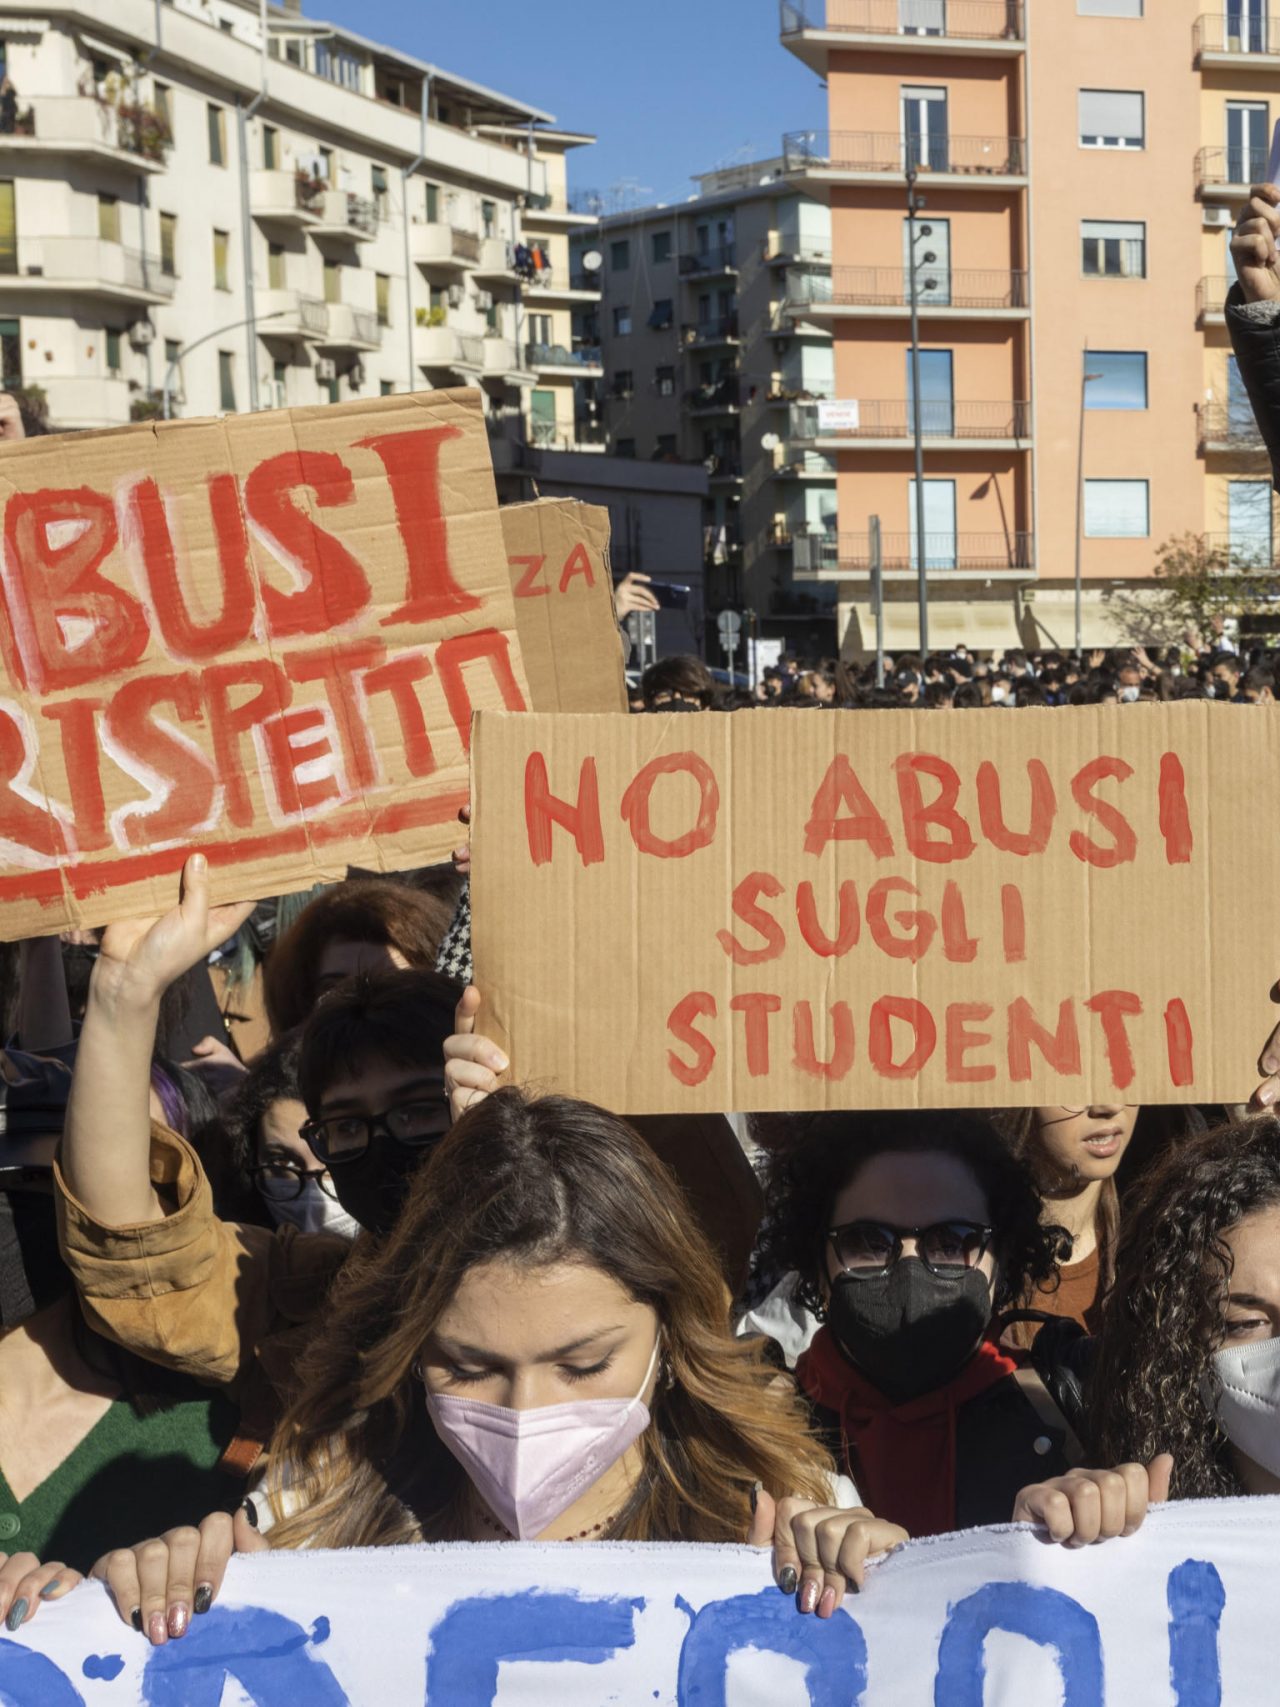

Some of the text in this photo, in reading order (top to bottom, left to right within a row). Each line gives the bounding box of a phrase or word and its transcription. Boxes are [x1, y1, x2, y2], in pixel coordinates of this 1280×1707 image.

[0, 427, 487, 694] BUSI
[508, 543, 596, 598] ZA
[525, 751, 1193, 866] NO ABUSI
[716, 871, 1027, 965] SUGLI
[666, 990, 1193, 1089] STUDENTI
